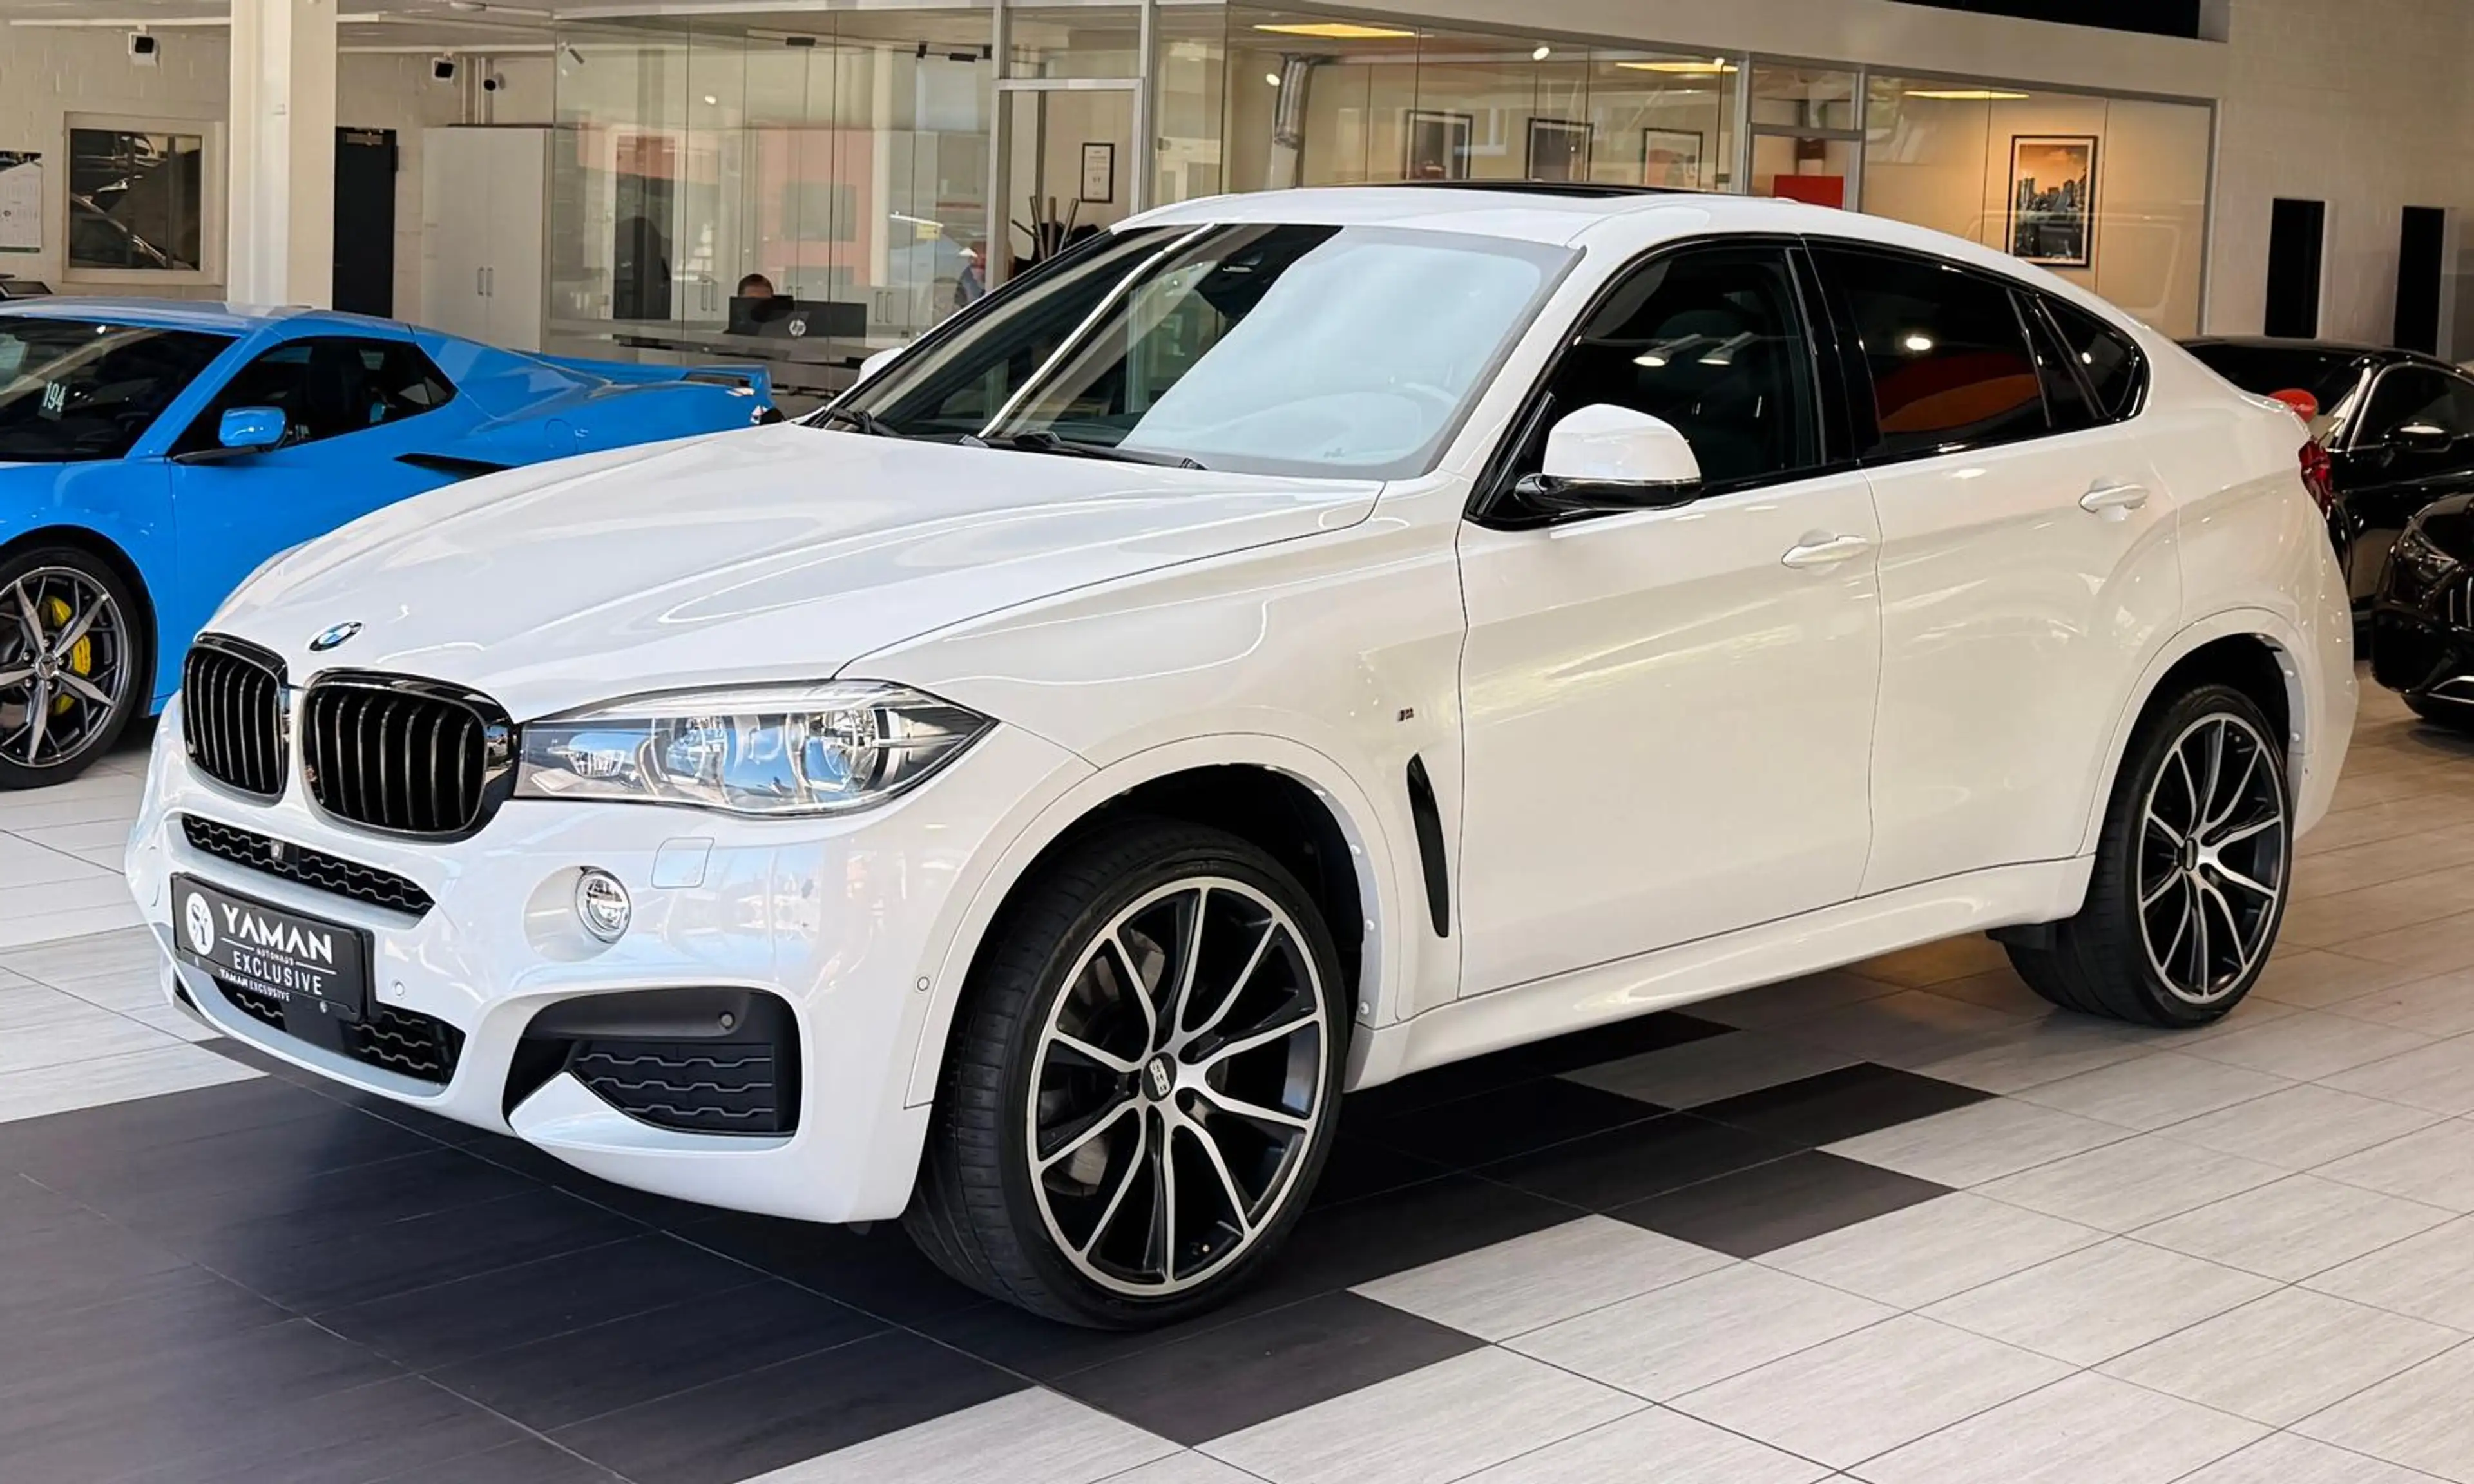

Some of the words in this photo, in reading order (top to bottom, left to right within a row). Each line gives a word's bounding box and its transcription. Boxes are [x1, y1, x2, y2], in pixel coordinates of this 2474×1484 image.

[43, 381, 66, 412] 194
[221, 902, 332, 964] YAMAN
[233, 951, 323, 996] EXCLUSIVE
